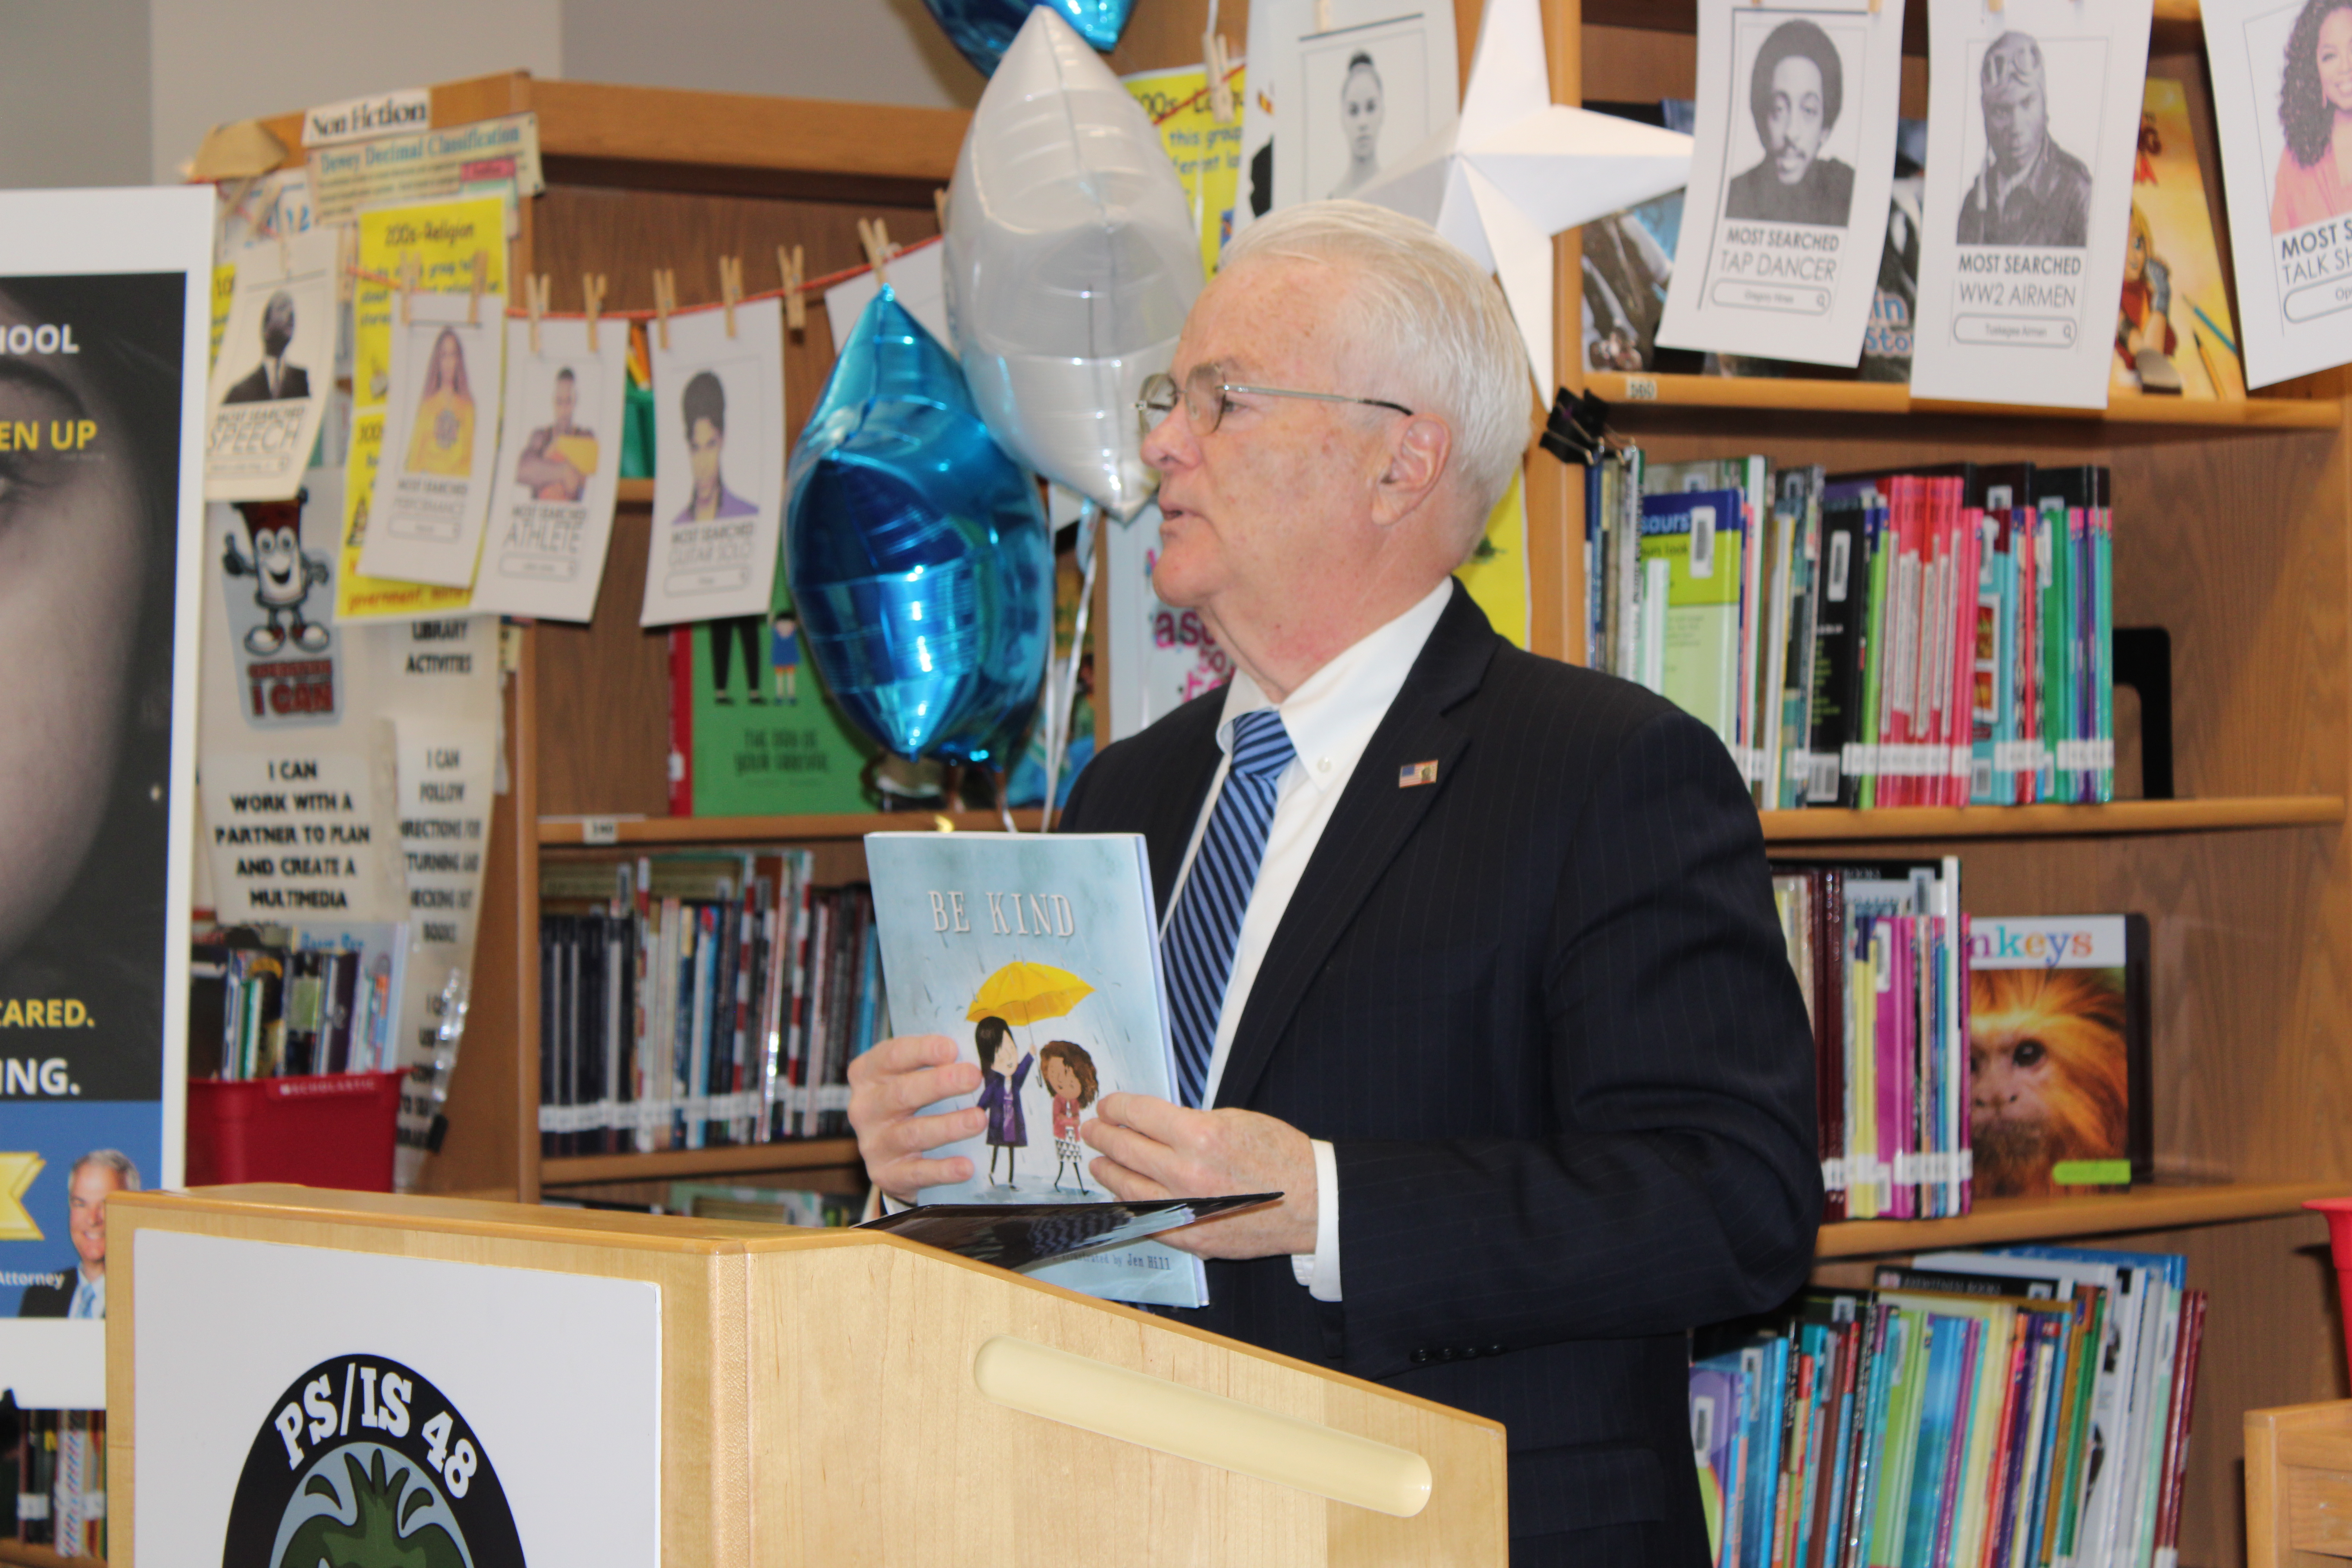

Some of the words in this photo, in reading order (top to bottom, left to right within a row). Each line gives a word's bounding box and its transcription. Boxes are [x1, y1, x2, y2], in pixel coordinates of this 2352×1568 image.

[312, 114, 347, 136] Non
[351, 99, 426, 131] Fiction
[365, 138, 422, 165] Decimal
[427, 125, 520, 155] Classification
[1726, 227, 1764, 247] MOST
[1768, 230, 1839, 252] SEARCHED
[2282, 223, 2337, 260] MOST
[1721, 250, 1753, 273] TAP
[1757, 253, 1836, 282] DANCER
[1958, 254, 2001, 273] MOST
[2004, 255, 2081, 275] SEARCHED
[2282, 253, 2329, 285] TALK
[1960, 281, 2004, 305] WW2
[2009, 283, 2076, 307] AIRMEN
[51, 419, 97, 450] UP
[207, 418, 301, 455] SPEECH
[512, 504, 541, 518] MOST
[544, 505, 587, 520] SEARCHED
[504, 518, 584, 554] ATHLETE
[671, 529, 702, 544] MOST
[705, 522, 755, 541] SEARCHED
[412, 621, 468, 641] LIBRARY
[252, 681, 265, 717] I
[270, 681, 334, 715] CAN
[268, 761, 276, 780] I
[280, 761, 318, 781] CAN
[426, 749, 432, 769] I
[435, 749, 460, 770] CAN
[230, 793, 287, 813] WORK
[293, 792, 338, 812] WITH
[341, 793, 353, 811] A
[419, 782, 465, 803] FOLLOW
[214, 826, 297, 845] PARTNER
[303, 826, 325, 845] TO
[330, 825, 370, 845] PLAN
[236, 857, 274, 878] AND
[280, 857, 340, 877] CREATE
[344, 857, 356, 877] A
[249, 889, 348, 909] MULTIMEDIA
[927, 890, 971, 933] BE
[986, 891, 1075, 937] KIND
[0, 998, 96, 1029] ARED.
[1127, 1253, 1144, 1267] Jen
[1147, 1256, 1171, 1270] Hill
[274, 1362, 412, 1470] PS/IS
[421, 1410, 477, 1499] 48
